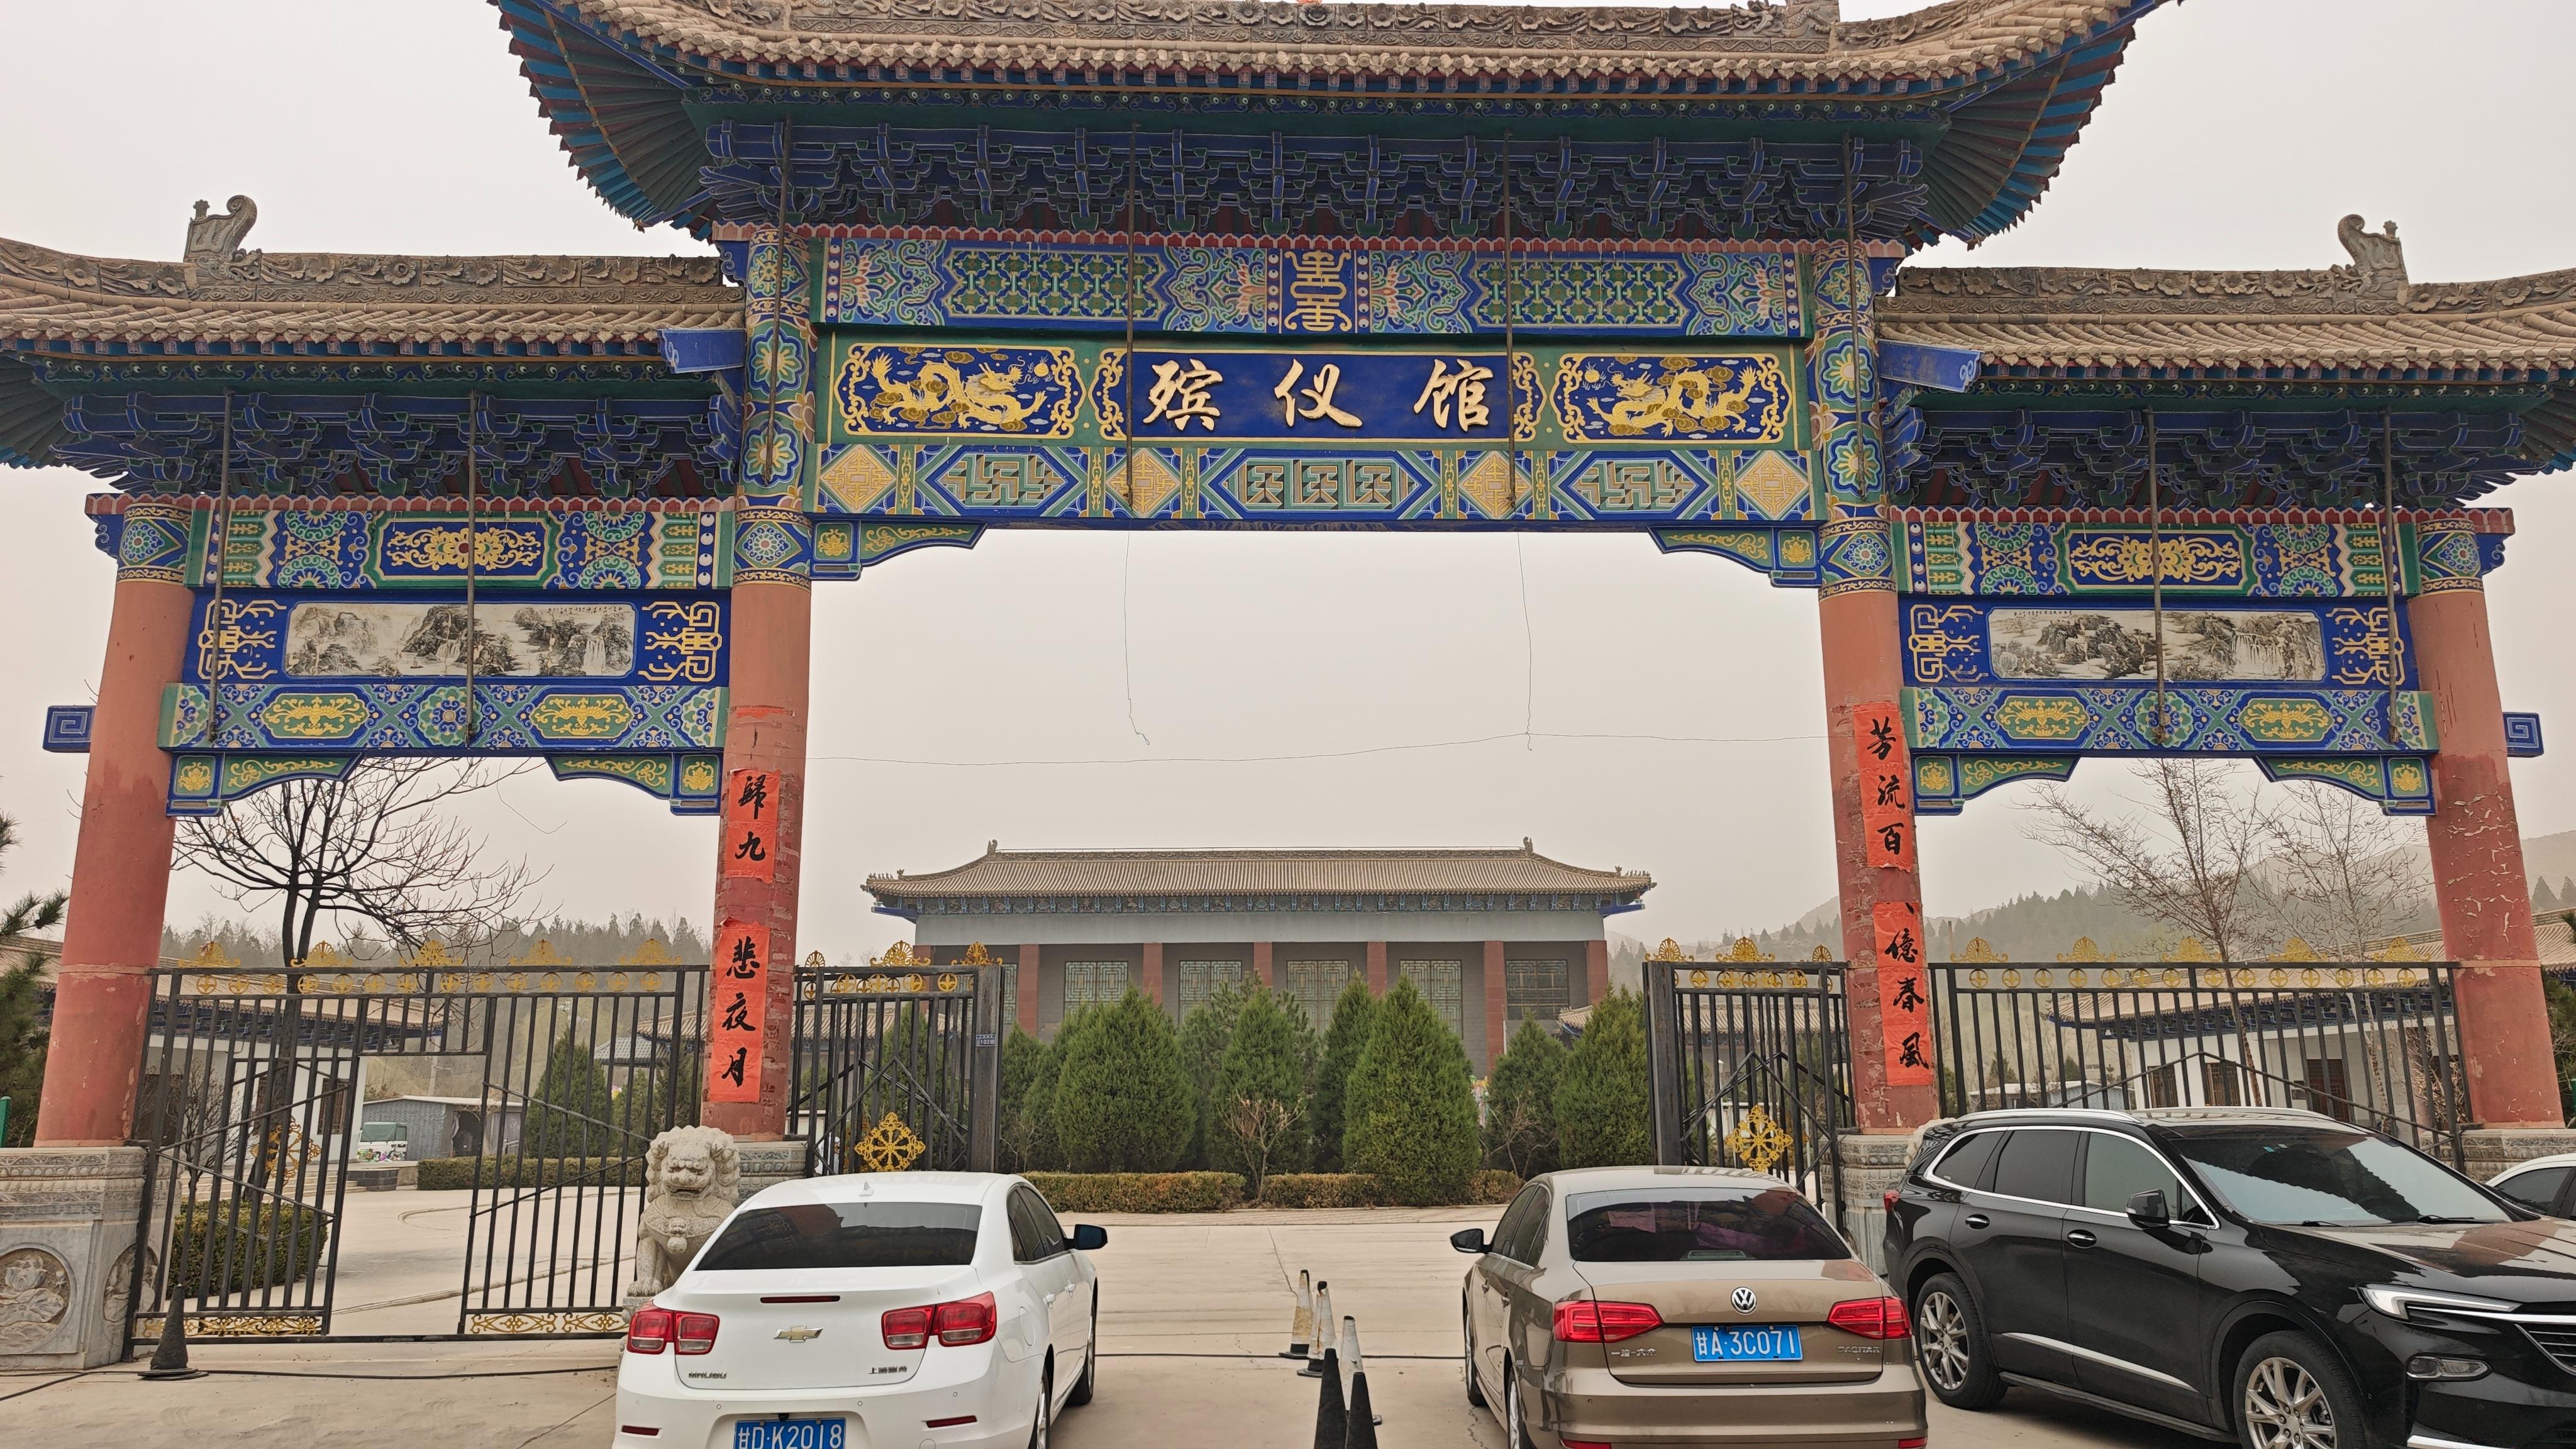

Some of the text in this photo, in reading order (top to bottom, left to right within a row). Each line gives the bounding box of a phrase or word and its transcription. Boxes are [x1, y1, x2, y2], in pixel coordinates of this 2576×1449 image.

[1142, 357, 1495, 433] 殡仪馆
[1837, 1346, 1880, 1354] SAGITAR
